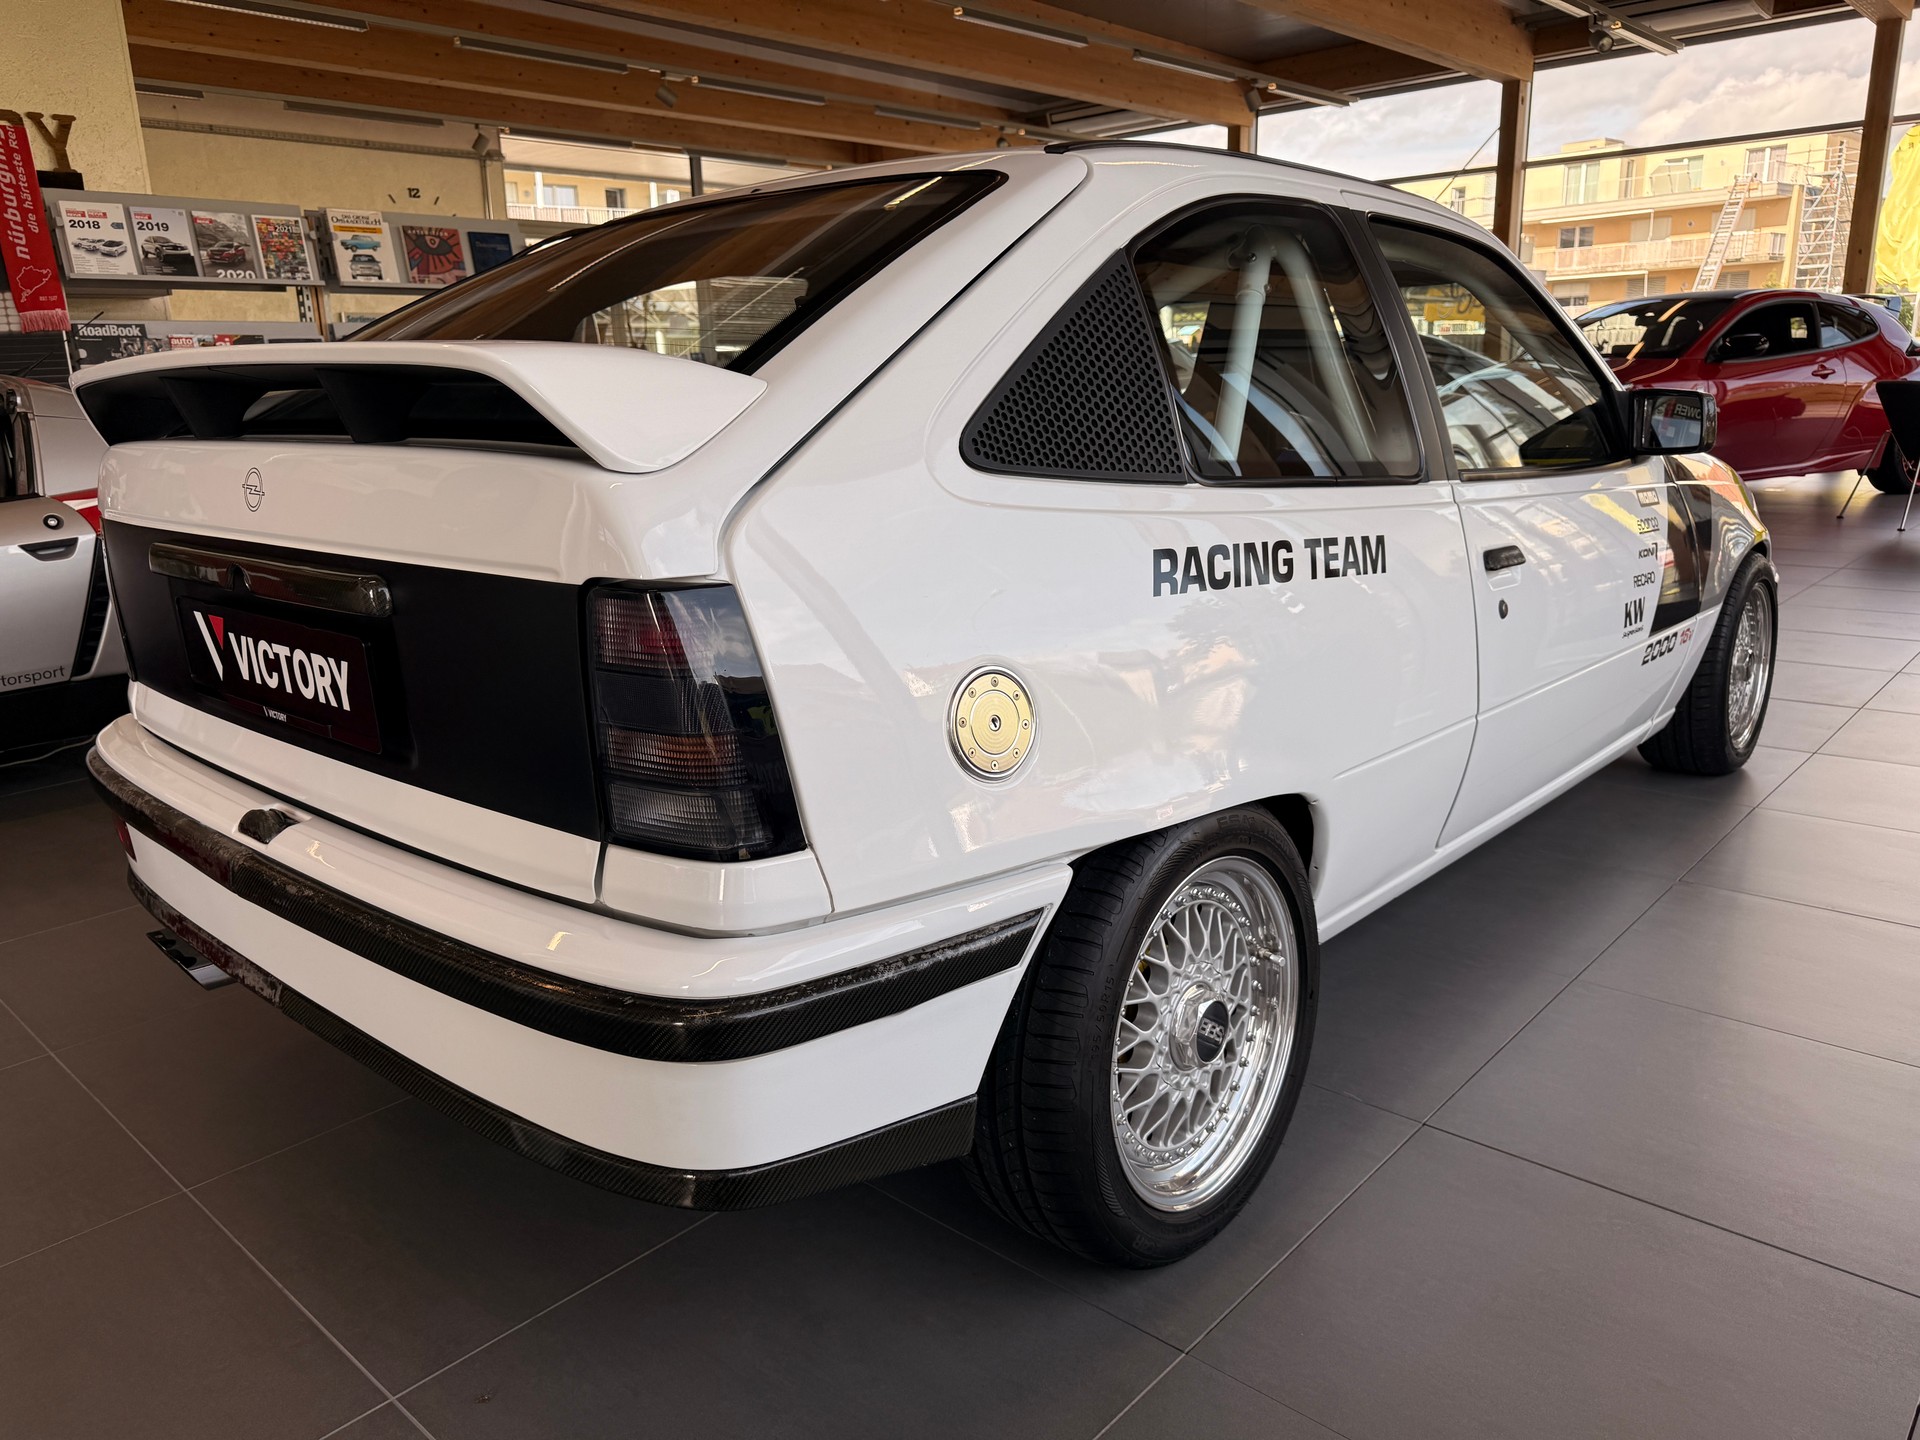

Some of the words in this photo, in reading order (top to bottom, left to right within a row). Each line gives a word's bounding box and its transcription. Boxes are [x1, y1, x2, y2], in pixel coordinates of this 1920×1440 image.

[14, 151, 35, 210] härteste
[406, 187, 421, 199] 12
[30, 212, 40, 234] die
[68, 219, 101, 230] 2018
[136, 221, 170, 232] 2019
[274, 224, 293, 233] 2021
[216, 269, 256, 279] 2020
[77, 324, 142, 336] RoadBook
[170, 337, 193, 345] auto
[1152, 540, 1294, 597] RACING
[1303, 534, 1387, 580] TEAM
[1633, 571, 1656, 588] RECARO
[1624, 596, 1646, 628] KW
[1641, 631, 1678, 666] 2000
[228, 632, 350, 711] VICTORY
[267, 709, 287, 722] VICTORY
[1200, 1017, 1225, 1045] BBS
